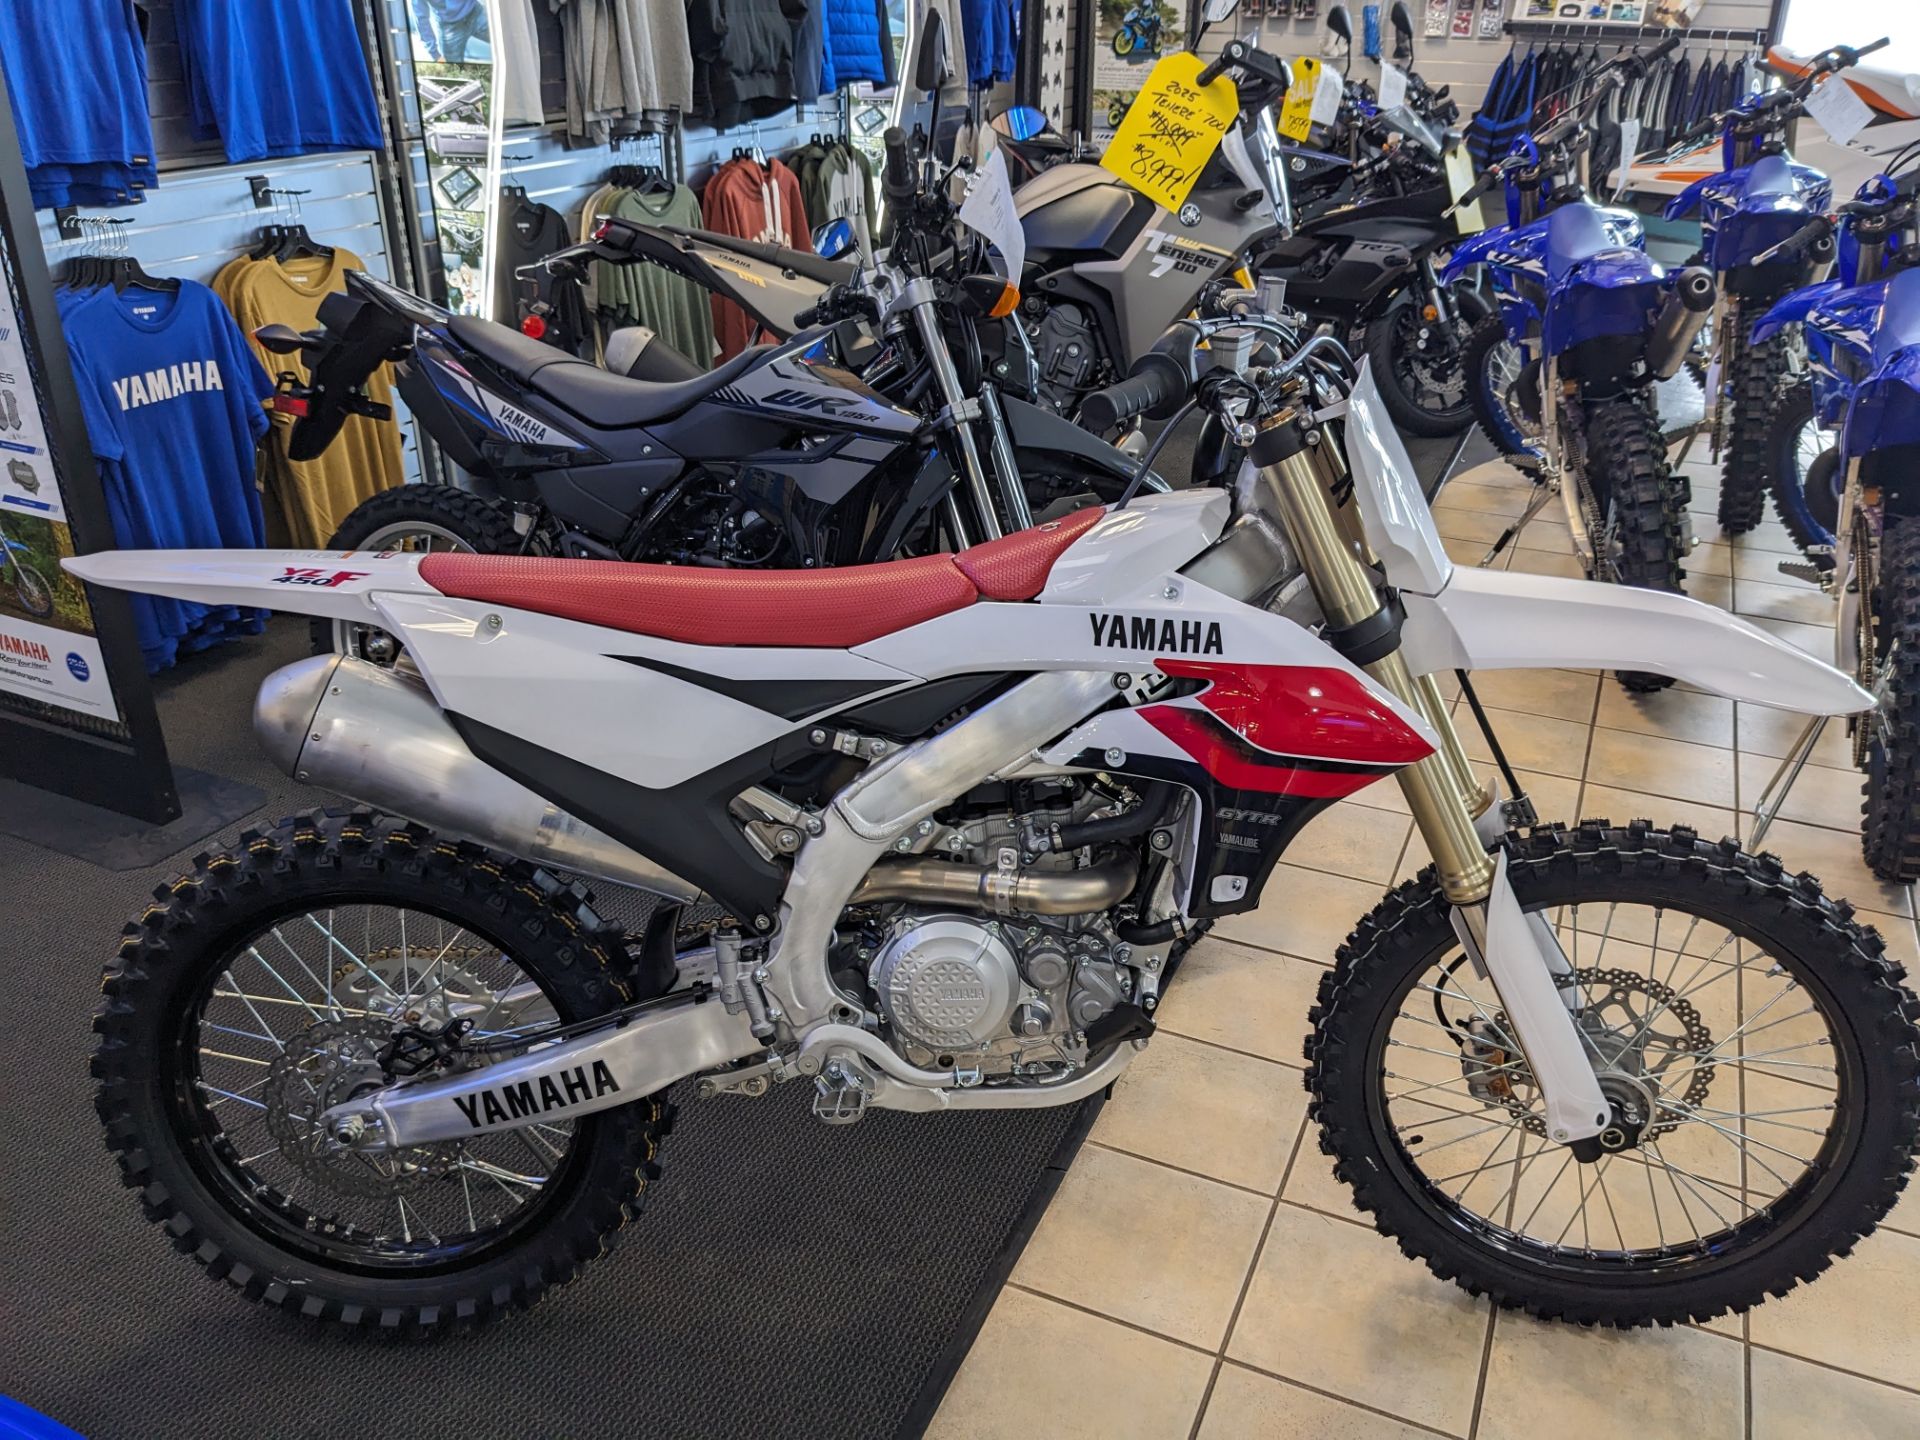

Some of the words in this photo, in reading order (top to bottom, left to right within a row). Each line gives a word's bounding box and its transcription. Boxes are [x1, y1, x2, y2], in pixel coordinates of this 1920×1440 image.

[1166, 80, 1201, 102] 2025
[1203, 112, 1226, 132] 700
[718, 253, 752, 270] YAMAHA
[112, 360, 224, 411] YAMAHA
[499, 404, 548, 441] YAMAHA
[1089, 612, 1223, 655] YAMAHA
[1216, 807, 1282, 826] GYTR
[1220, 832, 1260, 848] YAMALUBE
[939, 987, 985, 1001] YAMAHA
[453, 1059, 621, 1128] YAMAHA
